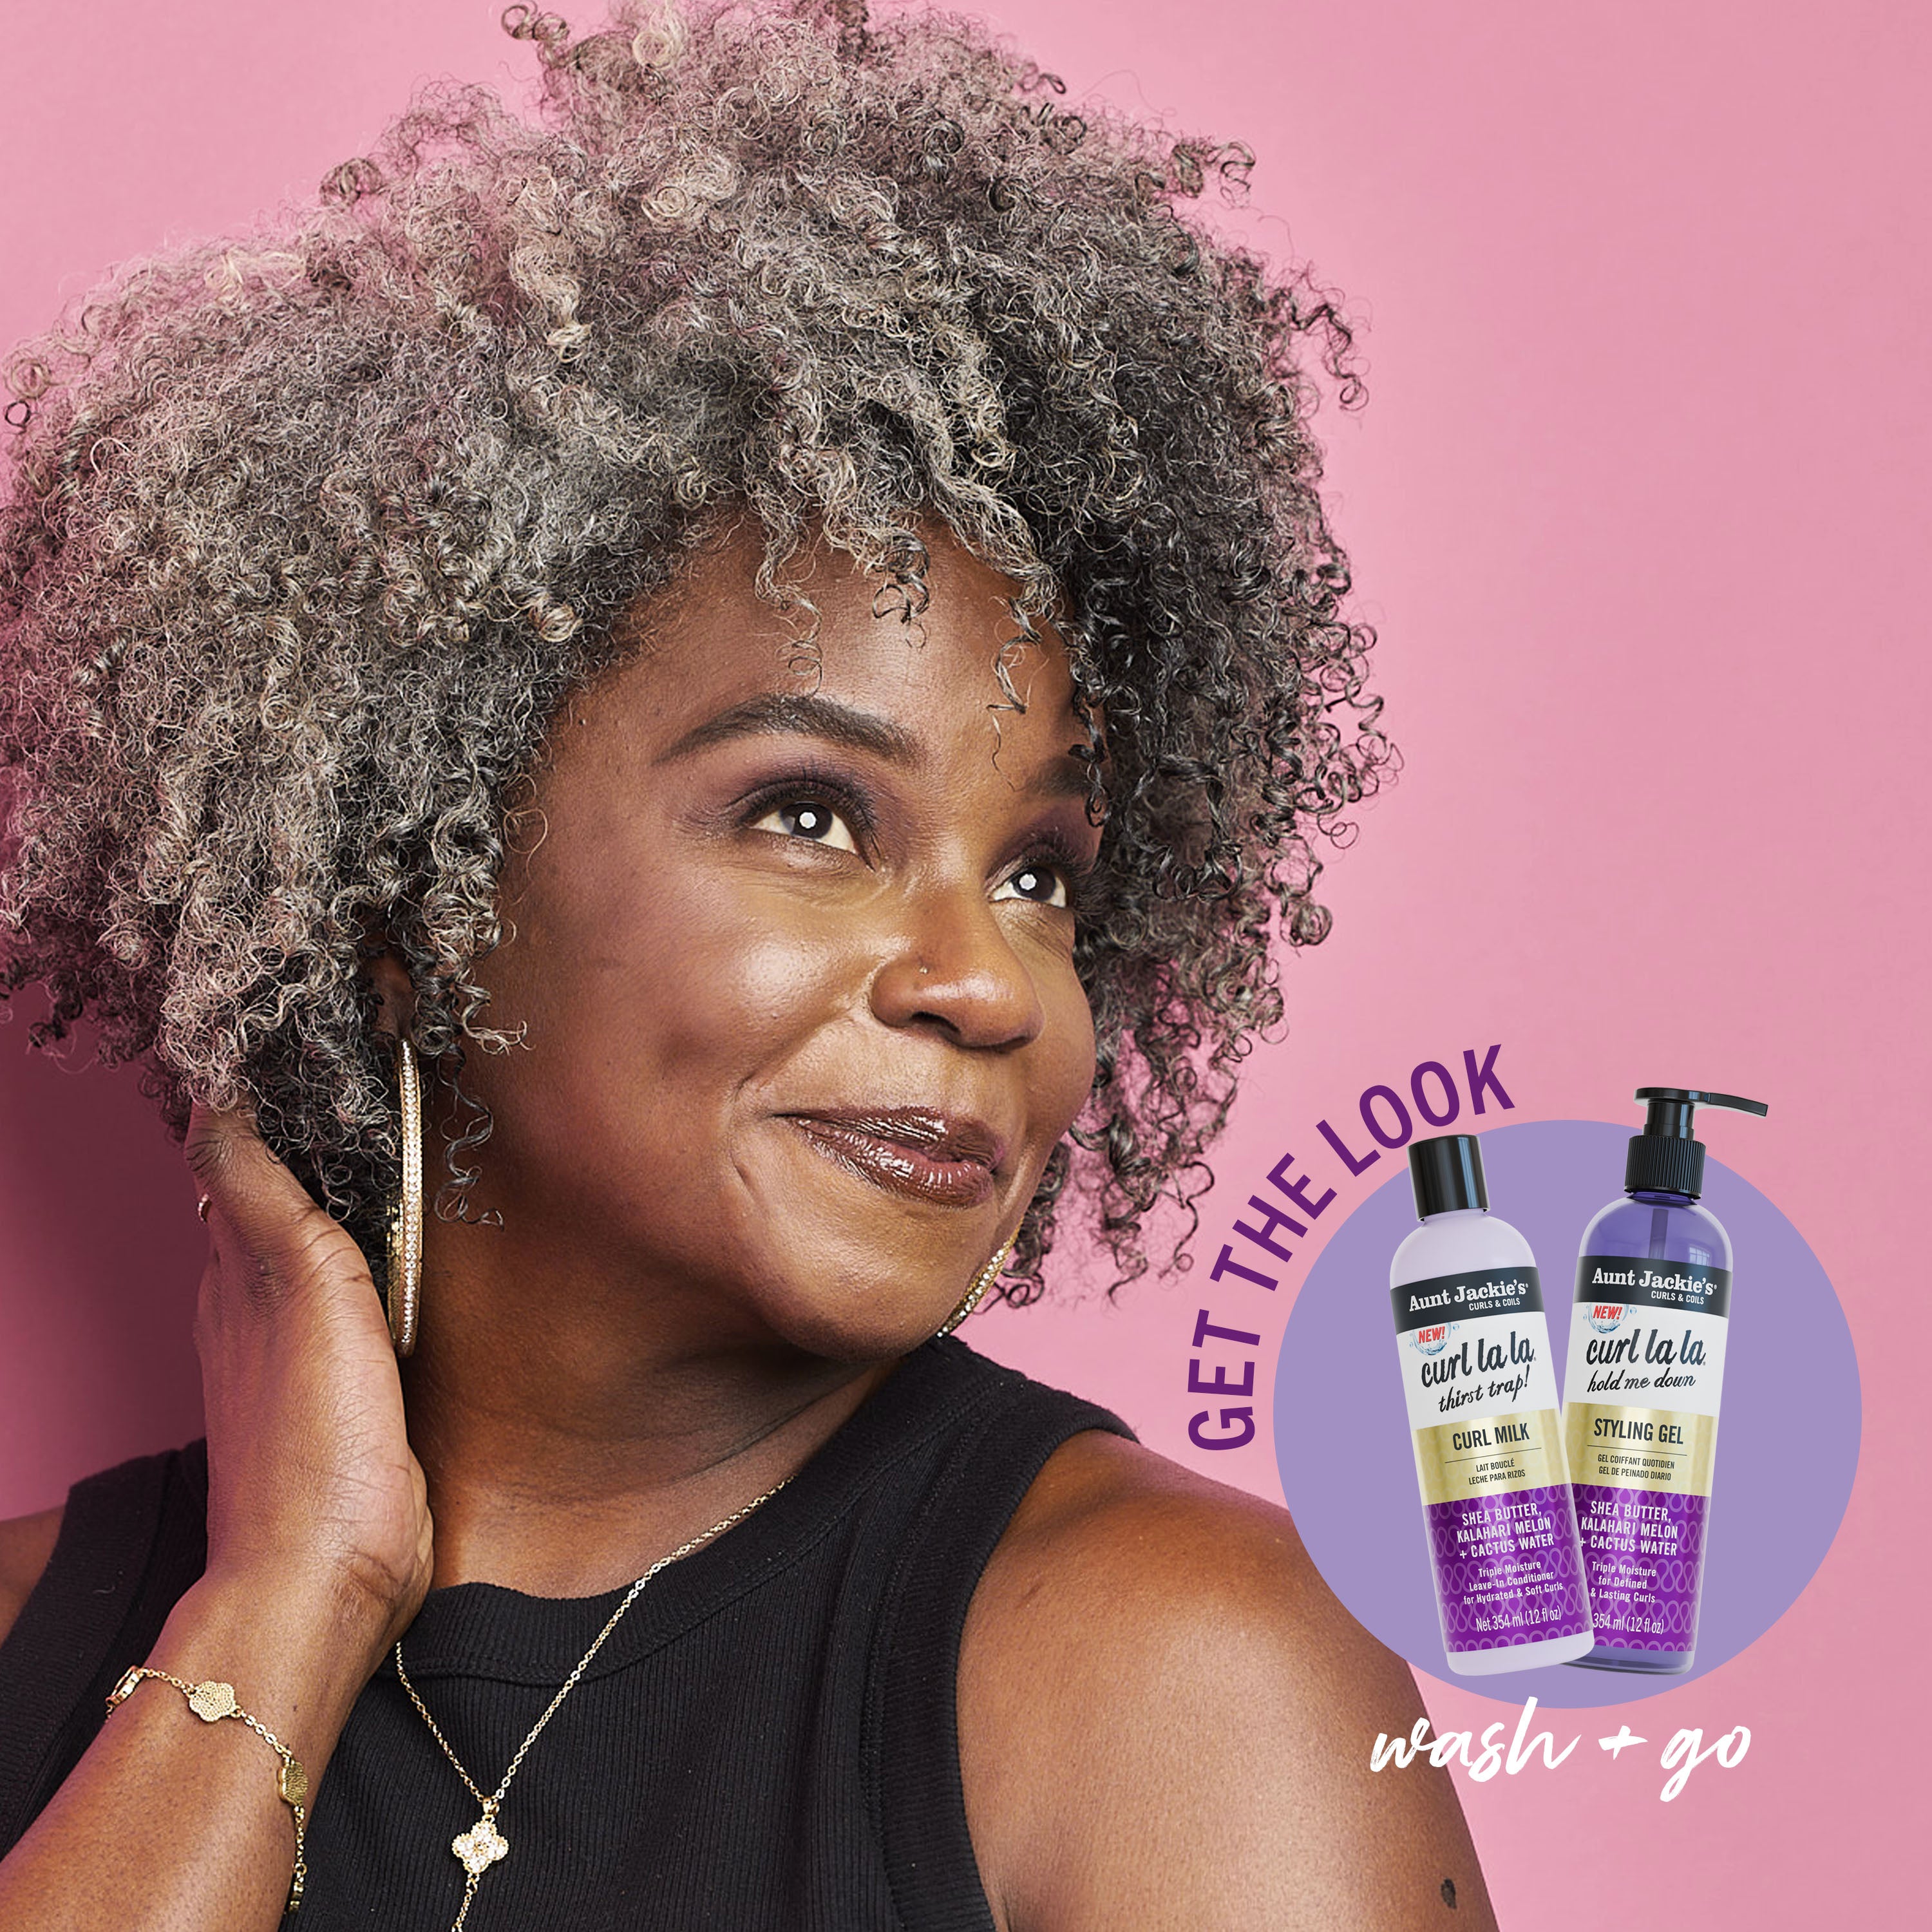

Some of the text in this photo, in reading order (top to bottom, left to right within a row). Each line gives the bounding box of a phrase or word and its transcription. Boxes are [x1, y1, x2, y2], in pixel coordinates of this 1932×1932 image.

[1591, 1267, 1714, 1296] Aunt Jackie's
[1408, 1279, 1527, 1312] Aunt Jackie's
[1468, 1301, 1493, 1311] CURLS
[1502, 1297, 1520, 1306] COILS
[1651, 1291, 1705, 1305] CURLS & COILS
[1593, 1305, 1623, 1320] NEW!
[1418, 1326, 1445, 1344] NEW!
[1586, 1329, 1707, 1366] curl la la
[1421, 1331, 1535, 1388] curl la la
[1438, 1364, 1530, 1413] thirst trap!
[1587, 1367, 1696, 1392] hold me down
[1452, 1423, 1530, 1451] CURL MILK
[1593, 1417, 1684, 1444] STYLING GEL
[1476, 1457, 1515, 1472] LAIT BOUCLÉ
[1598, 1454, 1675, 1470] GEL COIFFANT QUOTIDIEN
[1468, 1469, 1526, 1485] LECHE PARA RIZOS
[1598, 1466, 1672, 1481] GEL DE PEINADO DIARIO
[1462, 1502, 1542, 1526] SHEA BUTTER,
[1590, 1501, 1671, 1524] SHEA BUTTER,
[1457, 1517, 1551, 1544] KALAHARI MELON
[1581, 1517, 1678, 1539] KALAHARI MELON
[1459, 1533, 1555, 1559] + CACTUS WATER
[1579, 1535, 1677, 1556] + CACTUS WATER
[1478, 1561, 1541, 1578] Triple Moisture
[1592, 1561, 1656, 1577] Triple Moisture
[1469, 1571, 1554, 1592] Leave-In Conditioner
[1598, 1575, 1647, 1589] for Defined
[1463, 1582, 1564, 1605] for Hydrated & Soft Curls
[1590, 1587, 1656, 1603] & Lasting Curls
[1475, 1616, 1492, 1633] Net
[1492, 1614, 1511, 1631] 354
[1513, 1611, 1524, 1627] ml
[1525, 1609, 1541, 1626] (12
[1549, 1605, 1562, 1621] oz)
[1593, 1613, 1611, 1629] 354
[1613, 1616, 1625, 1631] ml
[1626, 1616, 1643, 1633] (12
[1651, 1618, 1664, 1635] oz)
